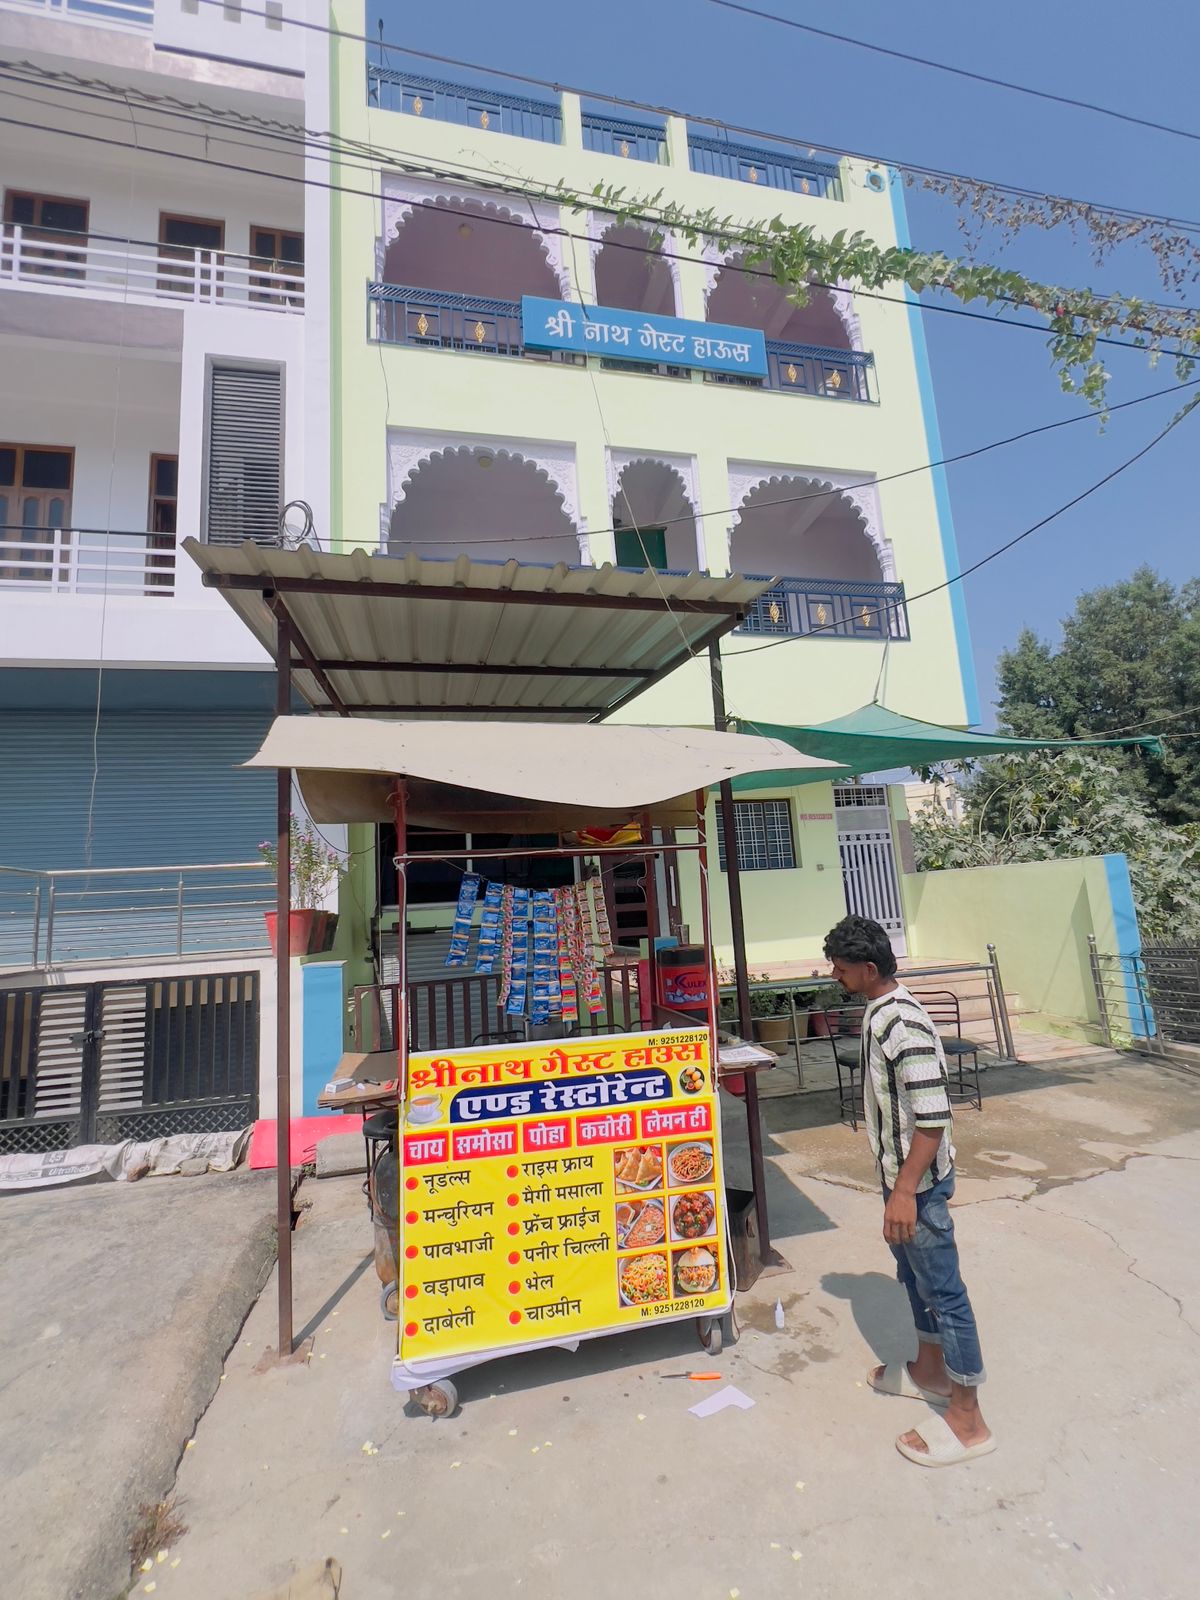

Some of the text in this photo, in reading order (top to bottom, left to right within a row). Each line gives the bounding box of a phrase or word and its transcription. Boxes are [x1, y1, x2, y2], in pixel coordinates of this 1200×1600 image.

[544, 309, 751, 363] श्री नाथ गेस्ट हाऊस
[648, 1033, 708, 1047] M: 9251228120
[410, 1042, 704, 1089] श्रीनाथ गेस्ट हाउस
[456, 1073, 666, 1120] एण्ड रेस्टोरेन्ट
[408, 1105, 708, 1160] चाय समोसा पोहा कचोरी लेमन टी
[48, 1165, 90, 1176] UltraTech
[521, 1155, 594, 1179] राइस फ्राय
[422, 1169, 472, 1195] नूडल्स
[522, 1181, 604, 1205] मैगी मसाला
[422, 1200, 495, 1227] मन्चुरियन
[523, 1206, 601, 1236] फ्रेंच फ्राईज
[422, 1231, 496, 1260] पावभाजी
[523, 1232, 611, 1263] पनीर चिल्ली
[422, 1273, 486, 1297] वड़ापाव
[525, 1271, 555, 1292] भेल
[422, 1305, 477, 1336] दाबेली
[524, 1296, 582, 1322] चाउमीन
[640, 1299, 706, 1317] M: 9251228120
